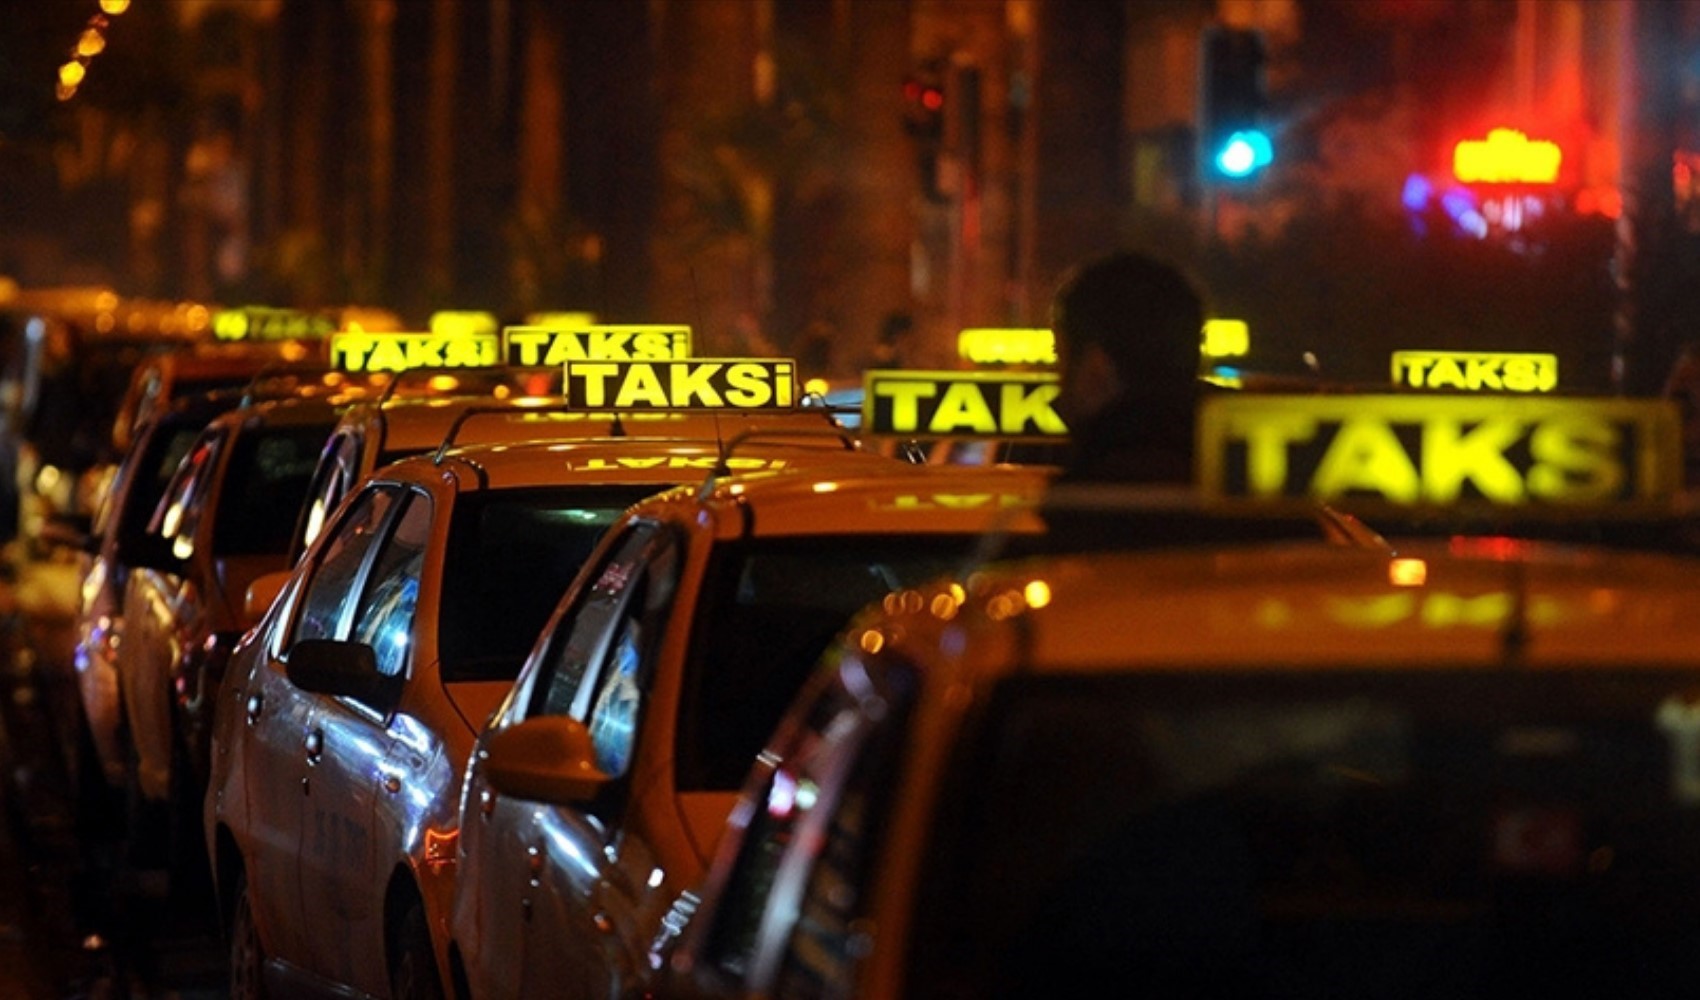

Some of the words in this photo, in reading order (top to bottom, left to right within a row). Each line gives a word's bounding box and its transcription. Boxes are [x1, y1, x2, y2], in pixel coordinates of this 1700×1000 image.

[510, 333, 689, 366] TAKSi
[571, 363, 793, 407] TAKSi
[875, 382, 1069, 434] TAK
